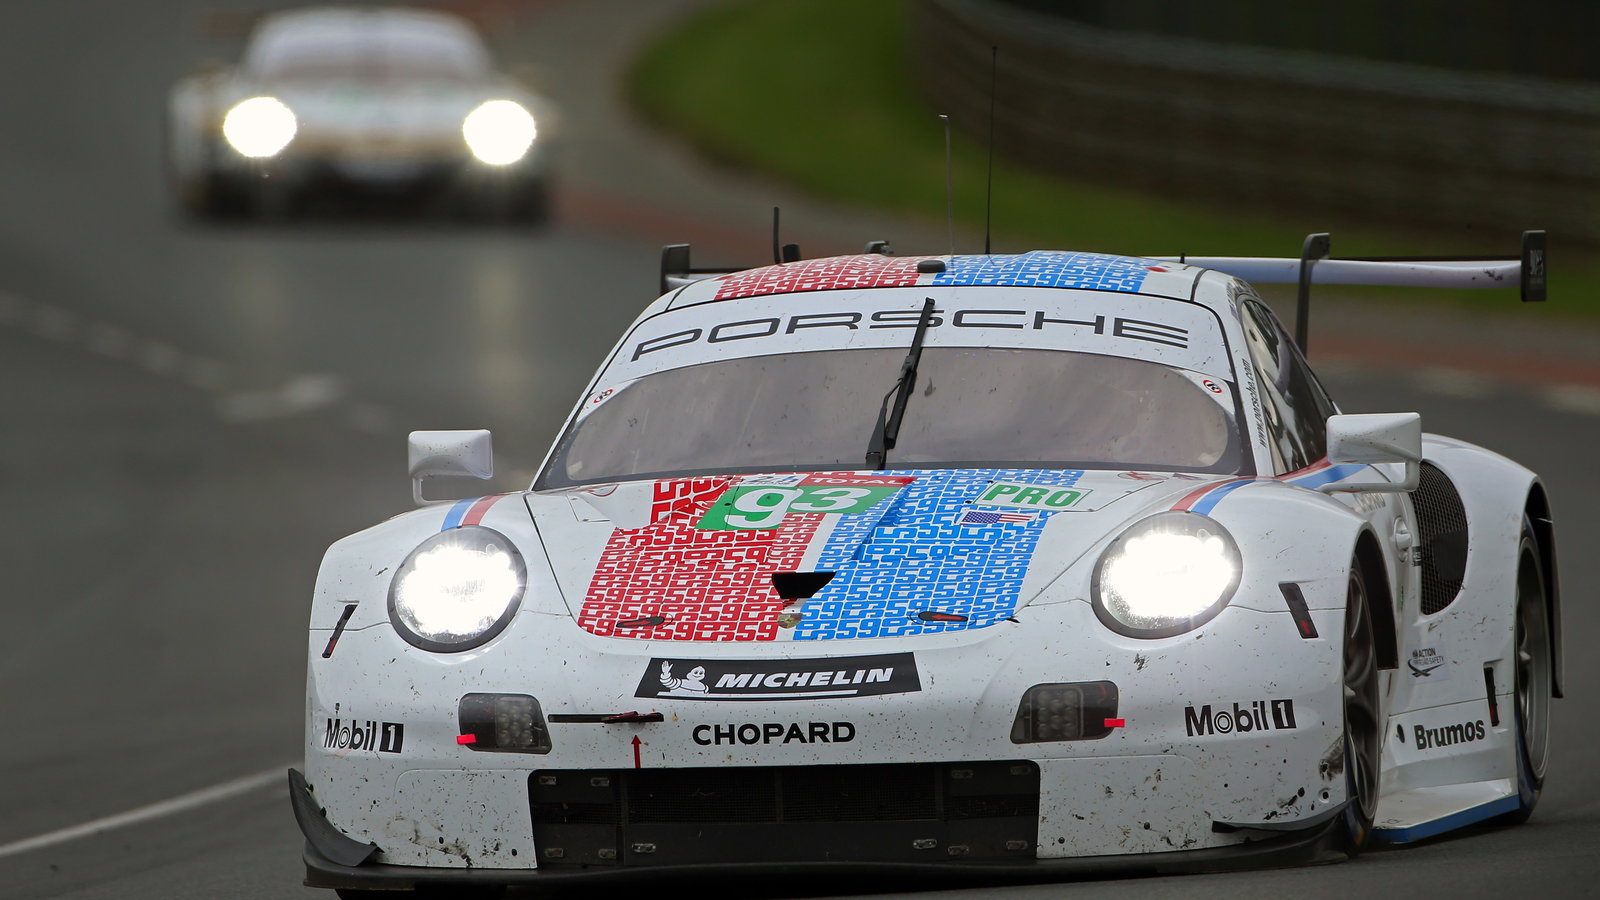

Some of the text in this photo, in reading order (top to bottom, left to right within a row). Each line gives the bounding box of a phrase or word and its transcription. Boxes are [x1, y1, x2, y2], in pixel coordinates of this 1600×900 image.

[631, 310, 1189, 363] PORSCHE
[1240, 358, 1268, 448] www.porsche.com
[810, 477, 903, 485] TOTAL
[982, 484, 1082, 507] PRO
[724, 488, 872, 529] 93
[714, 667, 895, 689] MICHELIN
[693, 721, 856, 746] CHOPARD
[1184, 700, 1294, 736] Mobil 1
[324, 717, 401, 752] Mobil 1
[1414, 720, 1486, 750] Brumos
